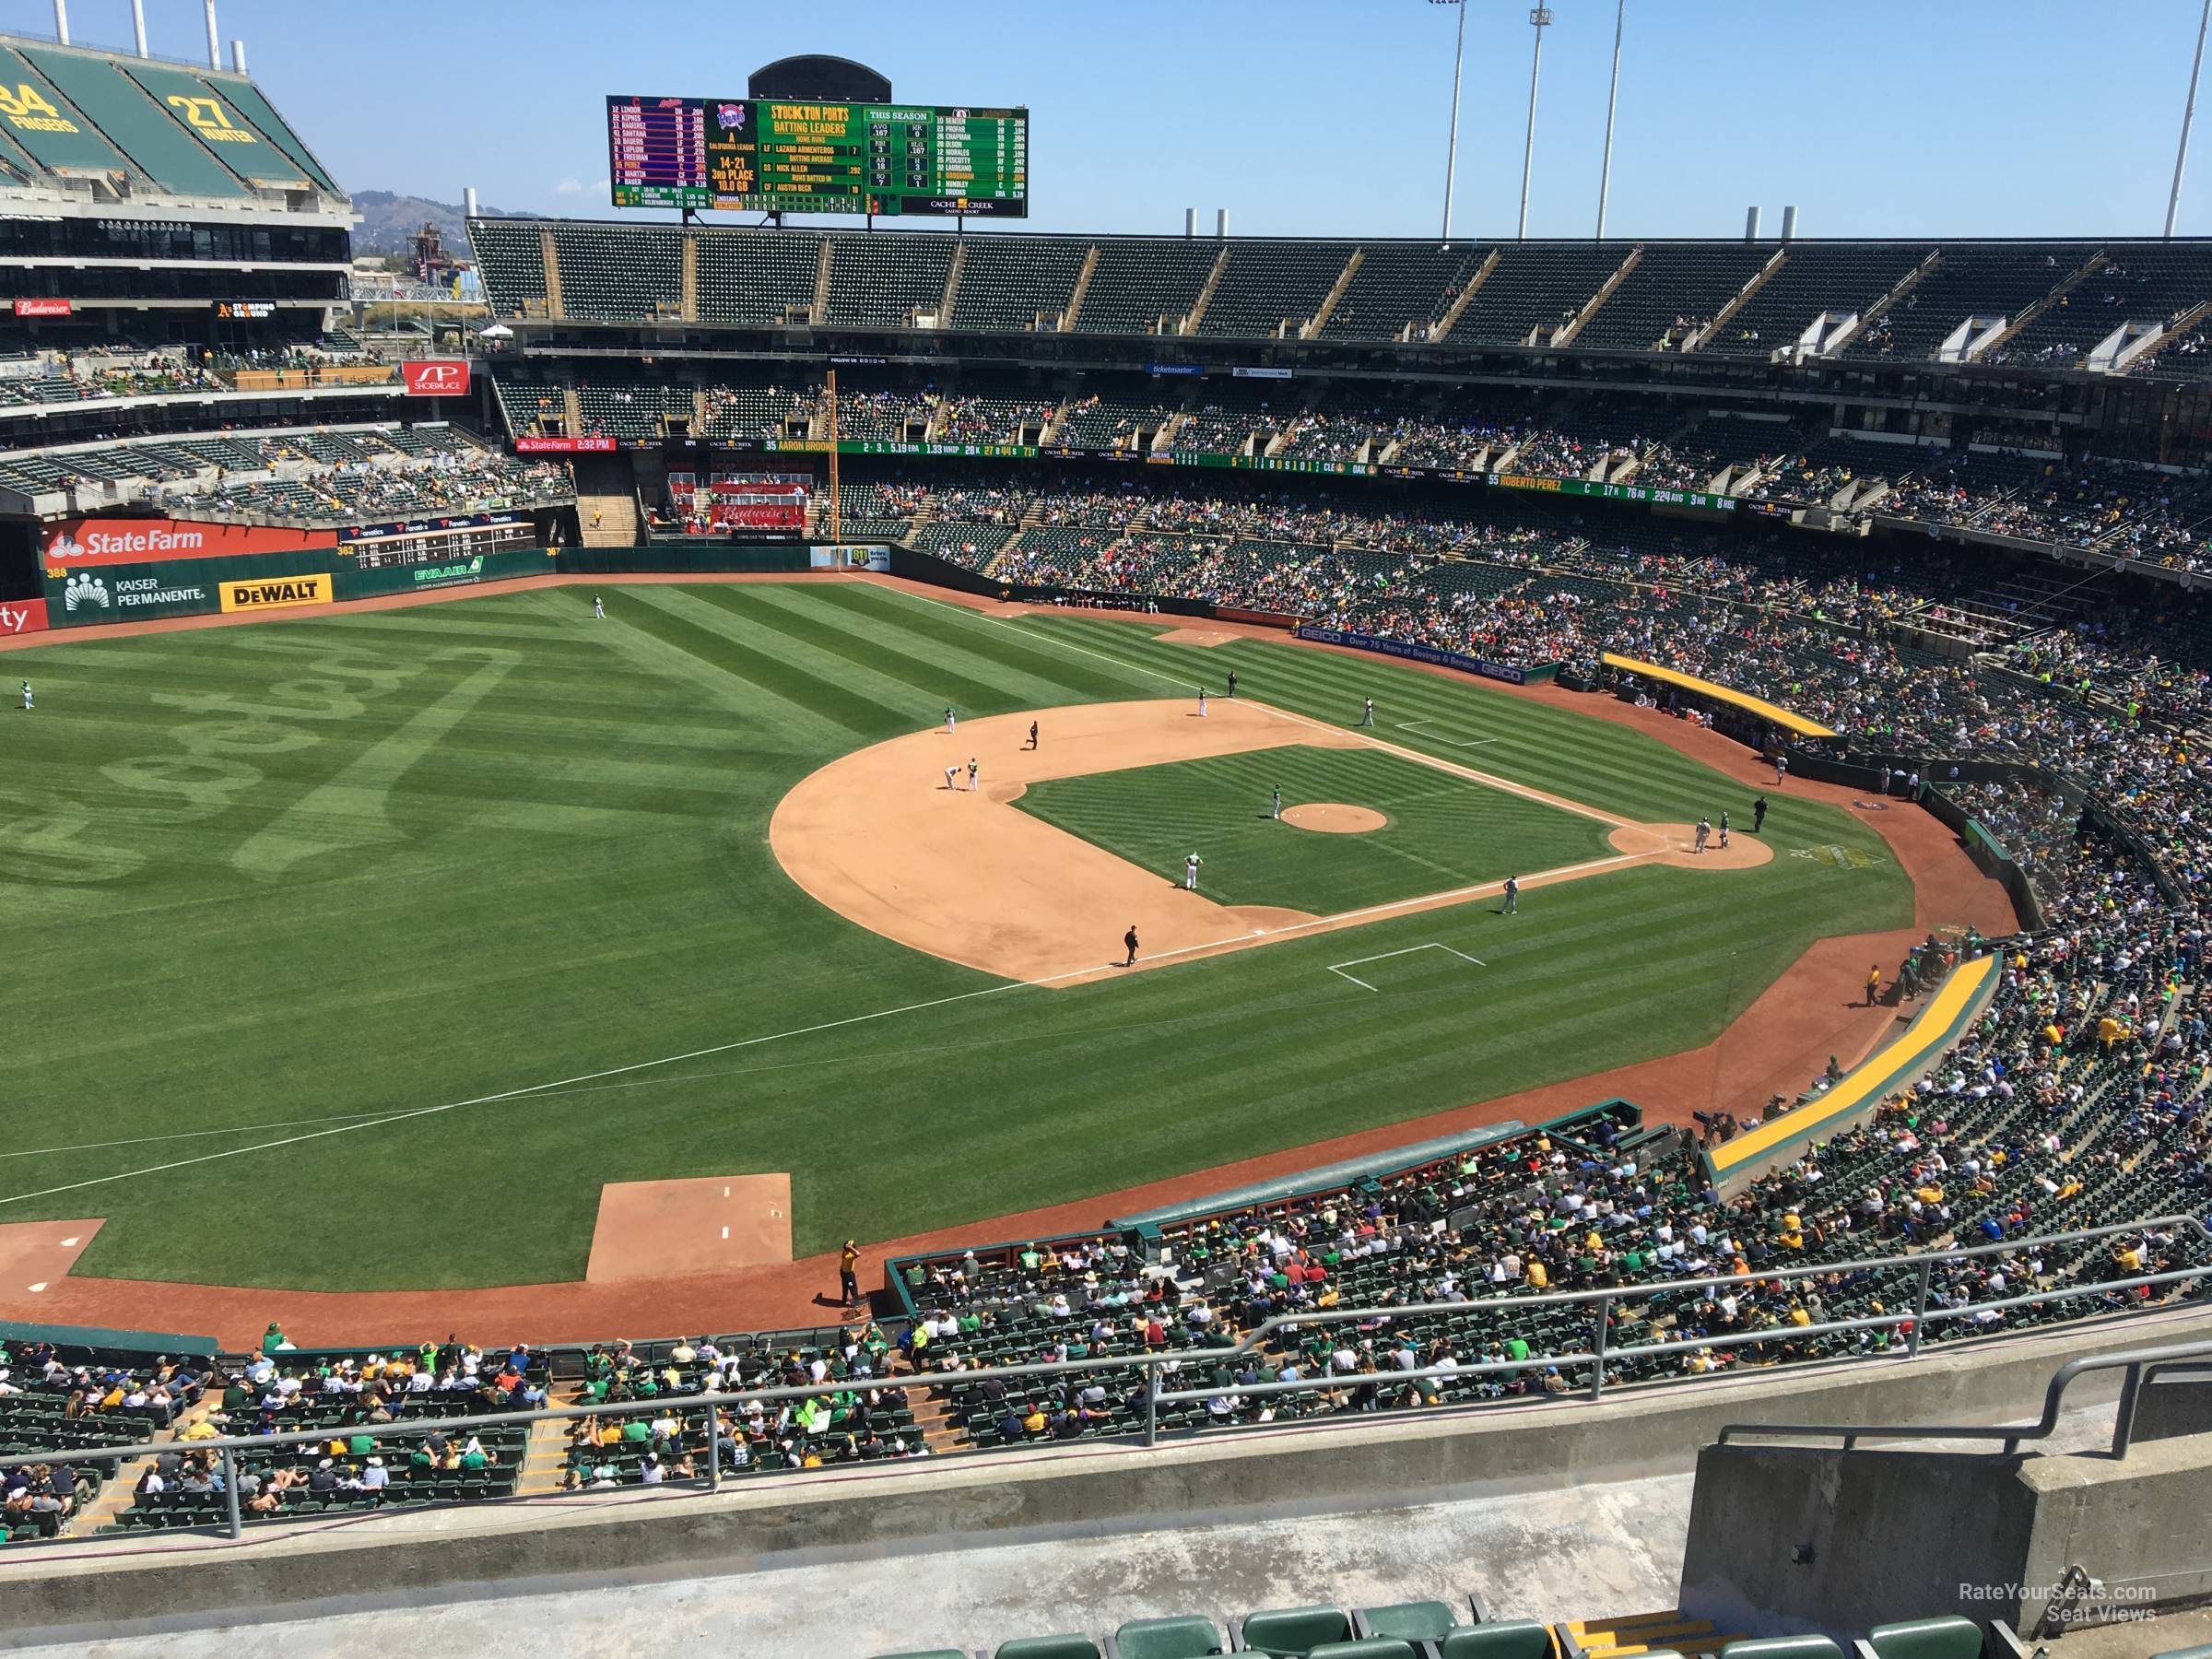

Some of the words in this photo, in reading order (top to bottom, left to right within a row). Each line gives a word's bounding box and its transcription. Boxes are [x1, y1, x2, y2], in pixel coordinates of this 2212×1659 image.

[0, 84, 59, 117] 34
[167, 95, 233, 128] 27
[771, 105, 820, 120] STOCKTON
[823, 107, 849, 121] PORTS
[893, 112, 927, 120] SEASON
[8, 115, 79, 134] FINGERS
[774, 121, 808, 133] BATTING
[811, 123, 846, 135] LEADERS
[198, 127, 257, 144] HUNTER
[728, 133, 735, 143] A
[720, 156, 745, 170] 14-21
[791, 164, 808, 172] ALLEN
[712, 169, 726, 180] 3RD
[728, 170, 754, 181] PLACE
[719, 180, 735, 191] 10.0
[737, 181, 748, 192] GB
[931, 200, 957, 208] CACHE
[18, 301, 68, 316] Budweiser
[1153, 366, 1195, 374] ticketmaster
[414, 382, 461, 390] SHOEPALACE
[577, 441, 594, 449] 2:32
[596, 441, 610, 449] PM
[766, 441, 777, 450] 35
[778, 441, 803, 451] AARON
[806, 441, 835, 452] BROOKS
[890, 443, 907, 453] 5.19
[908, 444, 919, 453] ERA
[926, 444, 942, 454] 1.33
[965, 445, 975, 454] 28
[984, 446, 993, 455] 27
[1001, 446, 1011, 455] 44
[1269, 460, 1275, 468] B
[1285, 461, 1290, 469] S
[1292, 461, 1297, 471] 1
[1307, 462, 1312, 471] 1
[1324, 463, 1335, 472] CLE
[1352, 465, 1366, 475] OAK
[1488, 474, 1499, 485] 55
[1500, 475, 1535, 488] ROBERTO
[1536, 477, 1562, 491] PEREZ
[1584, 484, 1591, 494] C
[1604, 485, 1613, 496] 17
[1613, 487, 1619, 495] H
[1627, 488, 1637, 499] 76
[1637, 489, 1646, 499] AB
[1652, 489, 1671, 502] .224
[1671, 493, 1684, 503] AVG
[1690, 495, 1697, 505] 3
[1697, 497, 1706, 506] HR
[1717, 498, 1723, 509] 8
[1723, 500, 1735, 510] RBI
[1774, 506, 1792, 514] CREEK
[489, 515, 512, 524] Fanatics
[337, 547, 355, 555] 362
[853, 548, 868, 560] 811
[47, 568, 67, 579] 388
[414, 568, 442, 581] EVA
[442, 564, 467, 577] AIR
[116, 579, 158, 592] KAISER
[1301, 628, 1342, 643] GEICO
[1349, 637, 1368, 646] Over
[1371, 640, 1380, 648] 75
[1382, 641, 1402, 653] Years
[1404, 646, 1411, 655] of
[1413, 648, 1441, 663] Savings
[1443, 653, 1449, 662] &
[1450, 655, 1475, 670] Service
[1481, 663, 1521, 682] GEICO
[394, 1383, 401, 1392] 9
[414, 1382, 426, 1391] 24
[734, 1453, 748, 1465] 22
